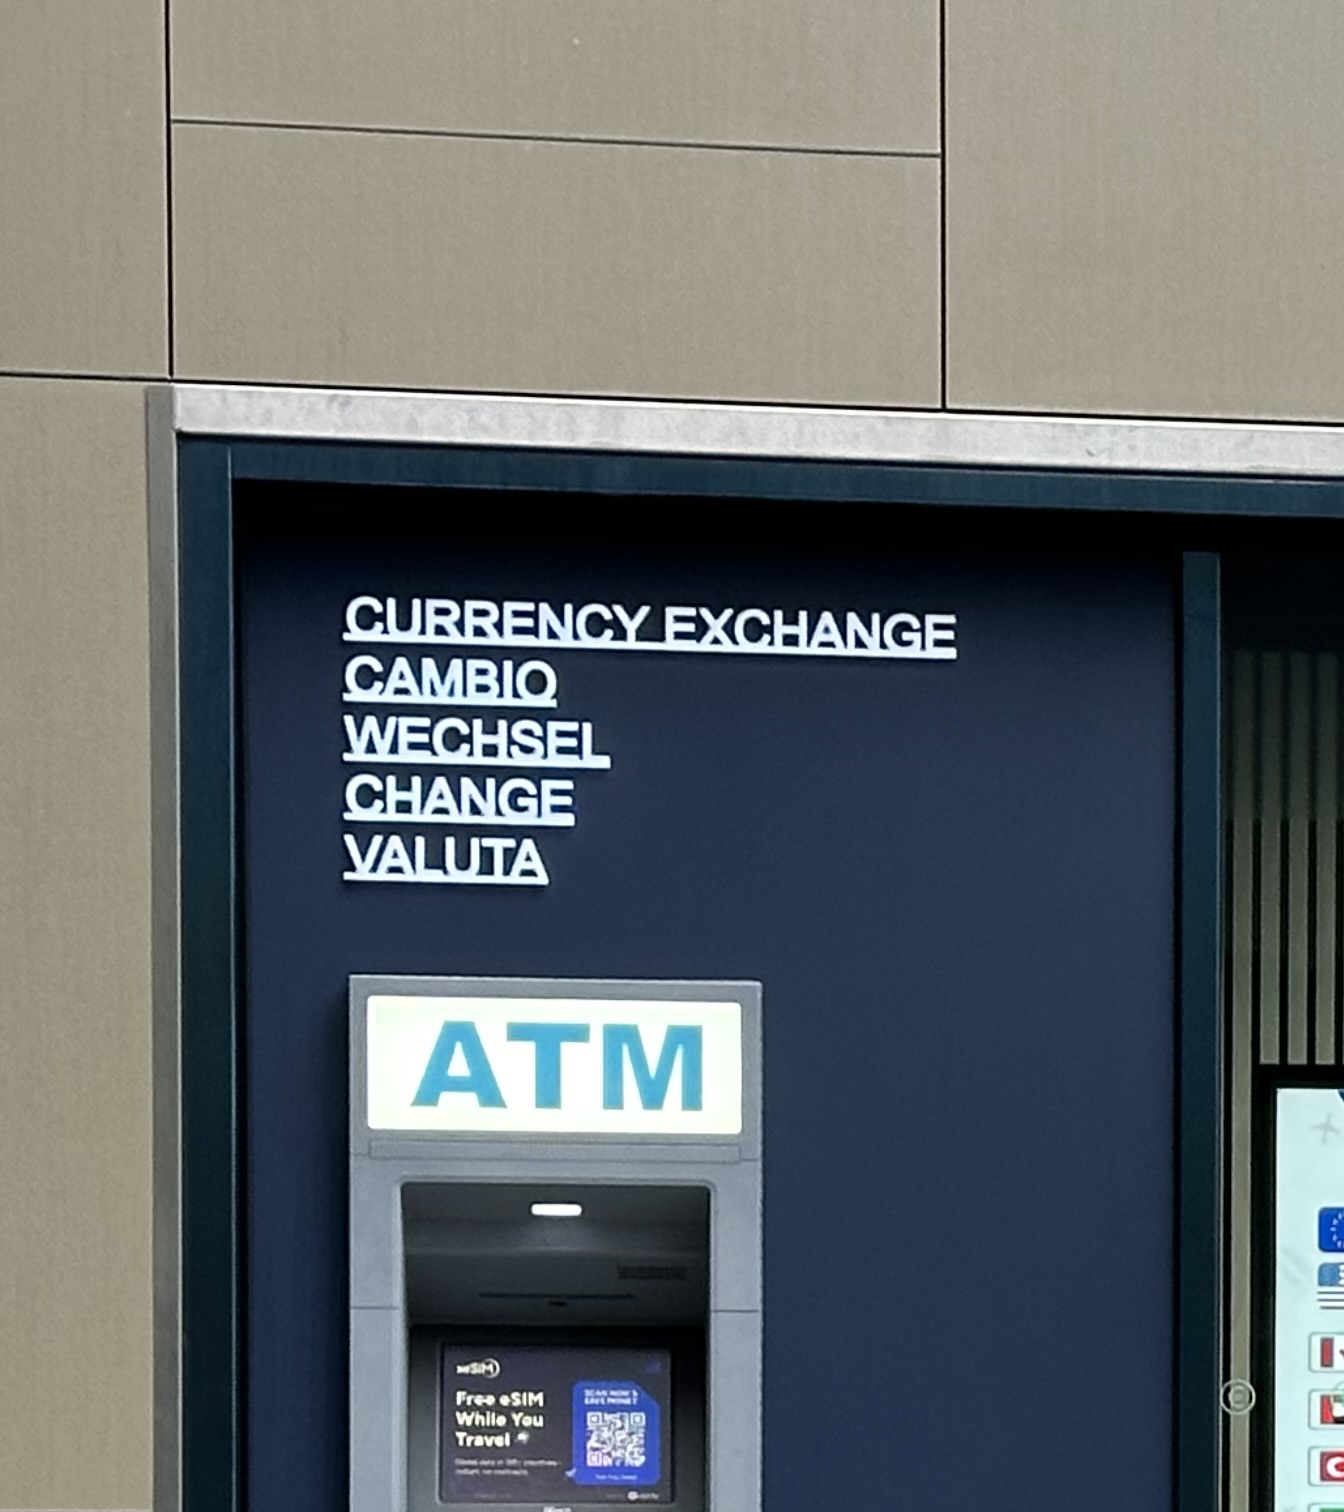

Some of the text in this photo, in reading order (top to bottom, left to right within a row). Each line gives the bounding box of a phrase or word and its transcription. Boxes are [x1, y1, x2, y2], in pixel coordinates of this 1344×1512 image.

[344, 596, 957, 656] CURRENCY EXCHANGE
[344, 655, 557, 704] CAMBIO
[344, 715, 611, 766] WECHSEL
[344, 774, 575, 823] CHANGE
[344, 833, 550, 882] VALUTA
[410, 1020, 704, 1111] ATM
[455, 1411, 544, 1428] While You
[456, 1391, 545, 1407] Free eSIM
[455, 1431, 511, 1447] Travel
